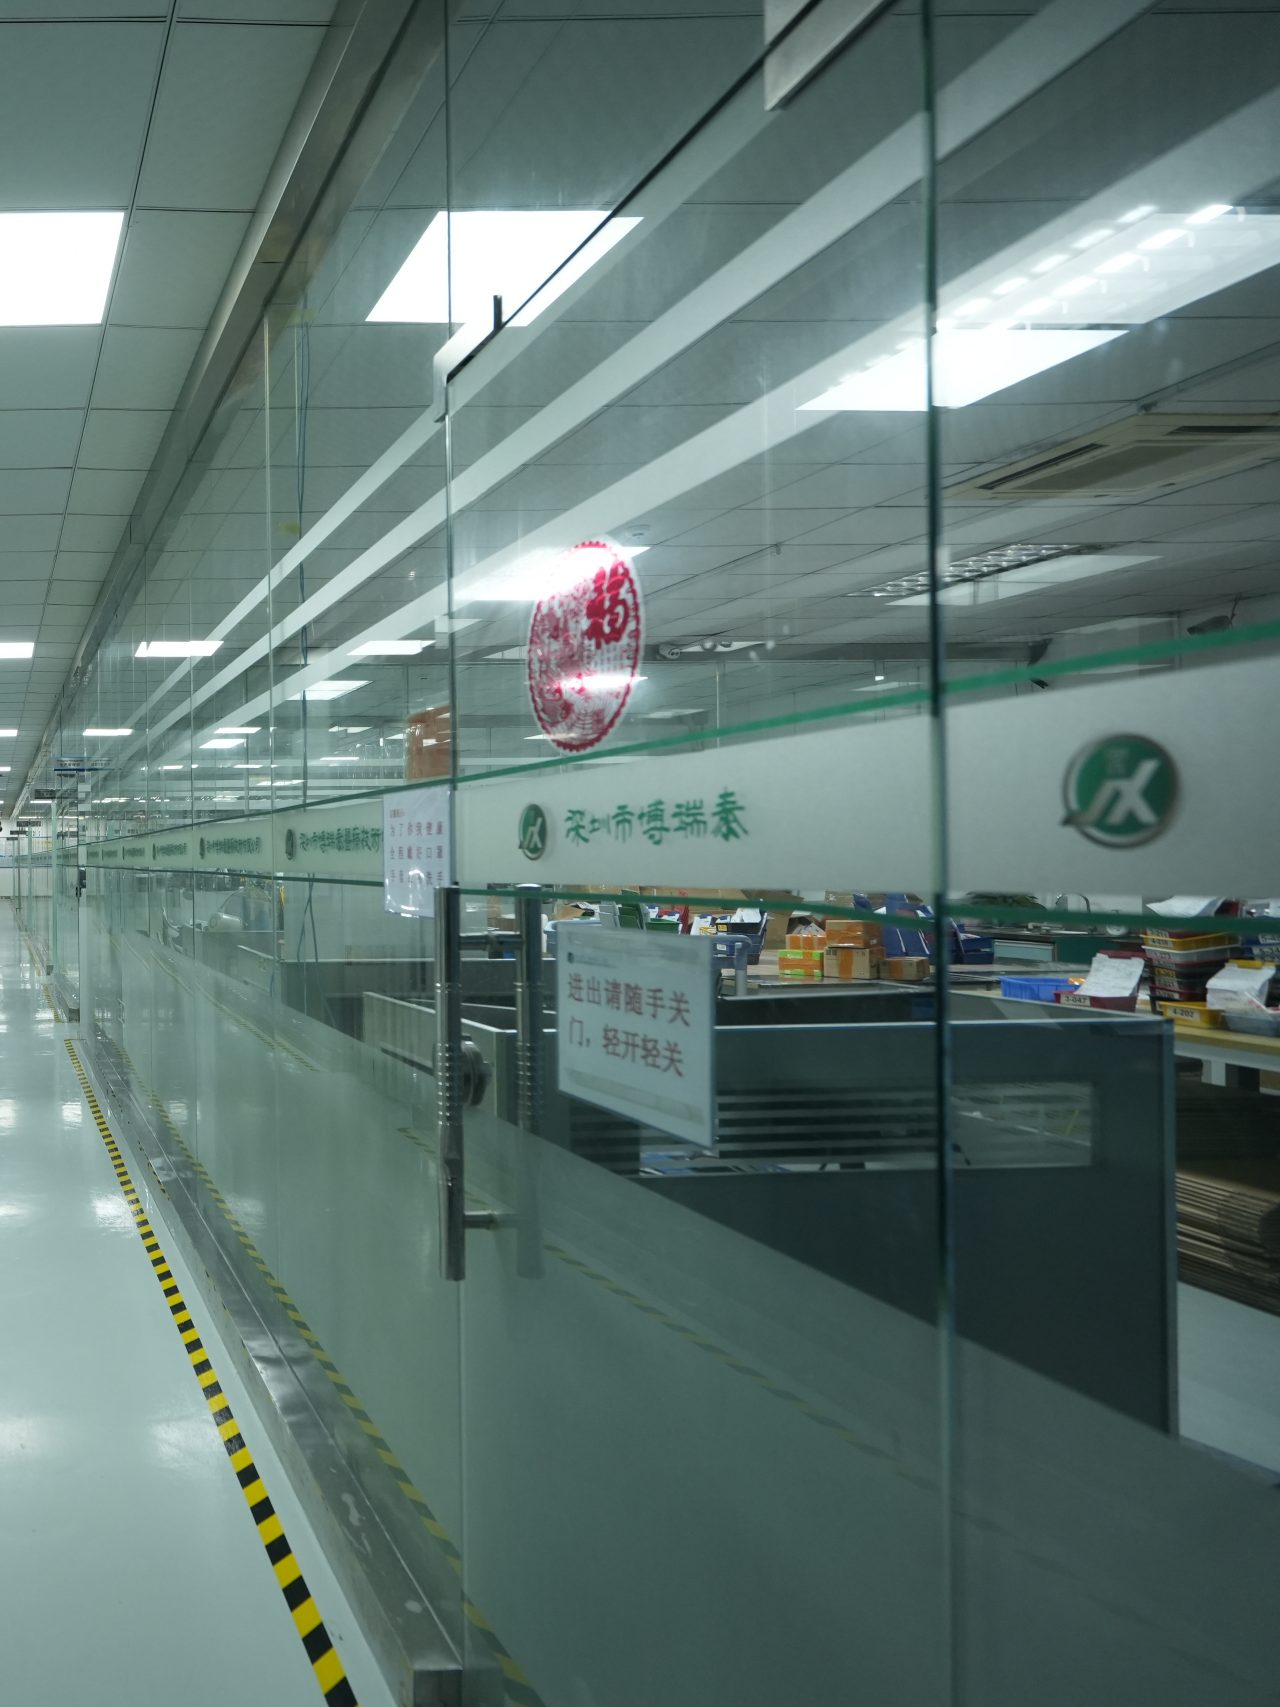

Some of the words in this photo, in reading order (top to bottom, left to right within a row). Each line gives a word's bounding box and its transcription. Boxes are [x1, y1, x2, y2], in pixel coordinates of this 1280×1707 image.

[564, 789, 749, 846] 深圳市博瑞泰
[568, 972, 690, 1027] 进出请随手关
